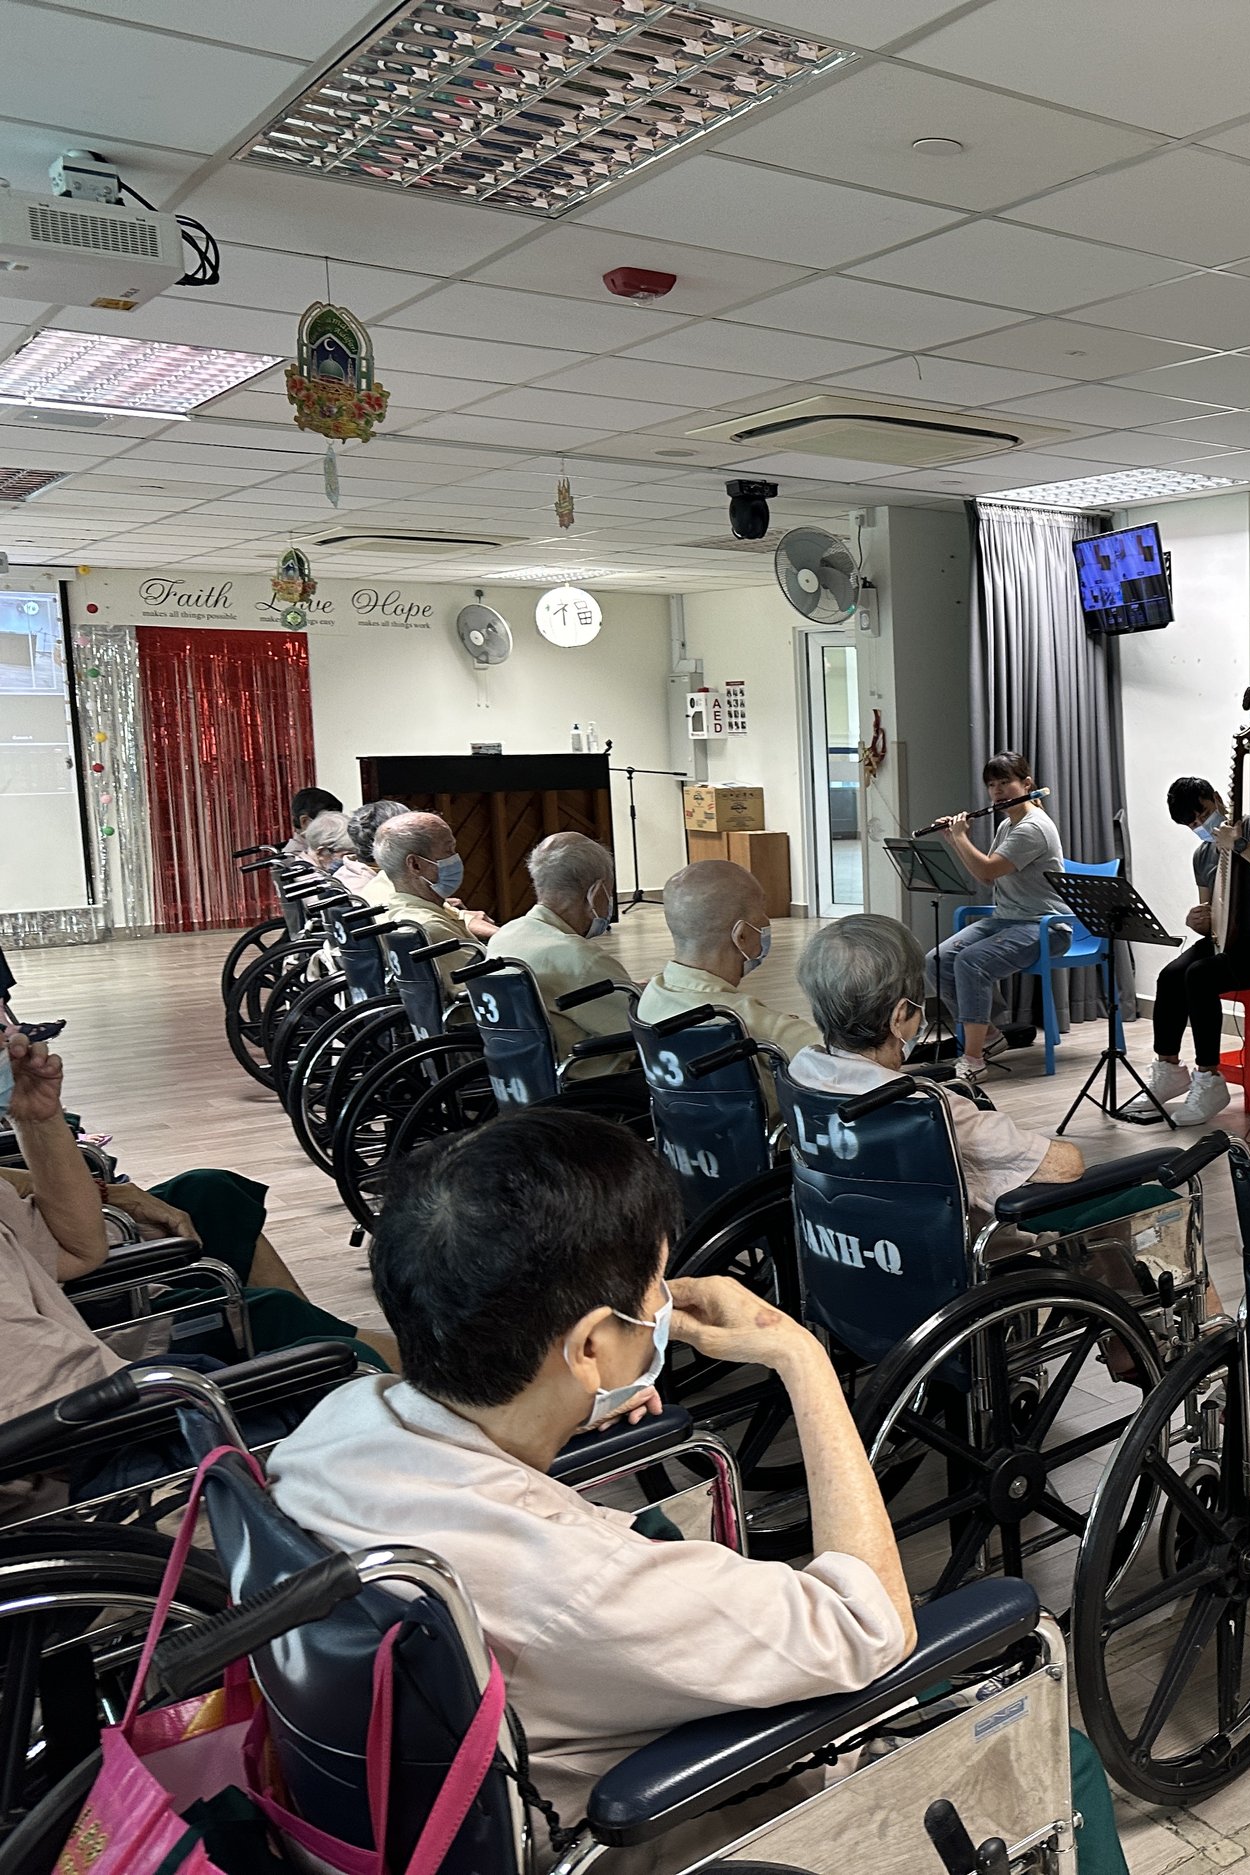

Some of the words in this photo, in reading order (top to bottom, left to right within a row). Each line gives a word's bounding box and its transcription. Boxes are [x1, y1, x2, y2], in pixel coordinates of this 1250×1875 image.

[139, 577, 233, 608] Faith
[351, 588, 434, 623] Hope
[181, 611, 205, 620] things
[207, 612, 237, 620] possible
[391, 621, 412, 629] things
[713, 698, 722, 733] AED
[793, 1104, 859, 1160] L-6
